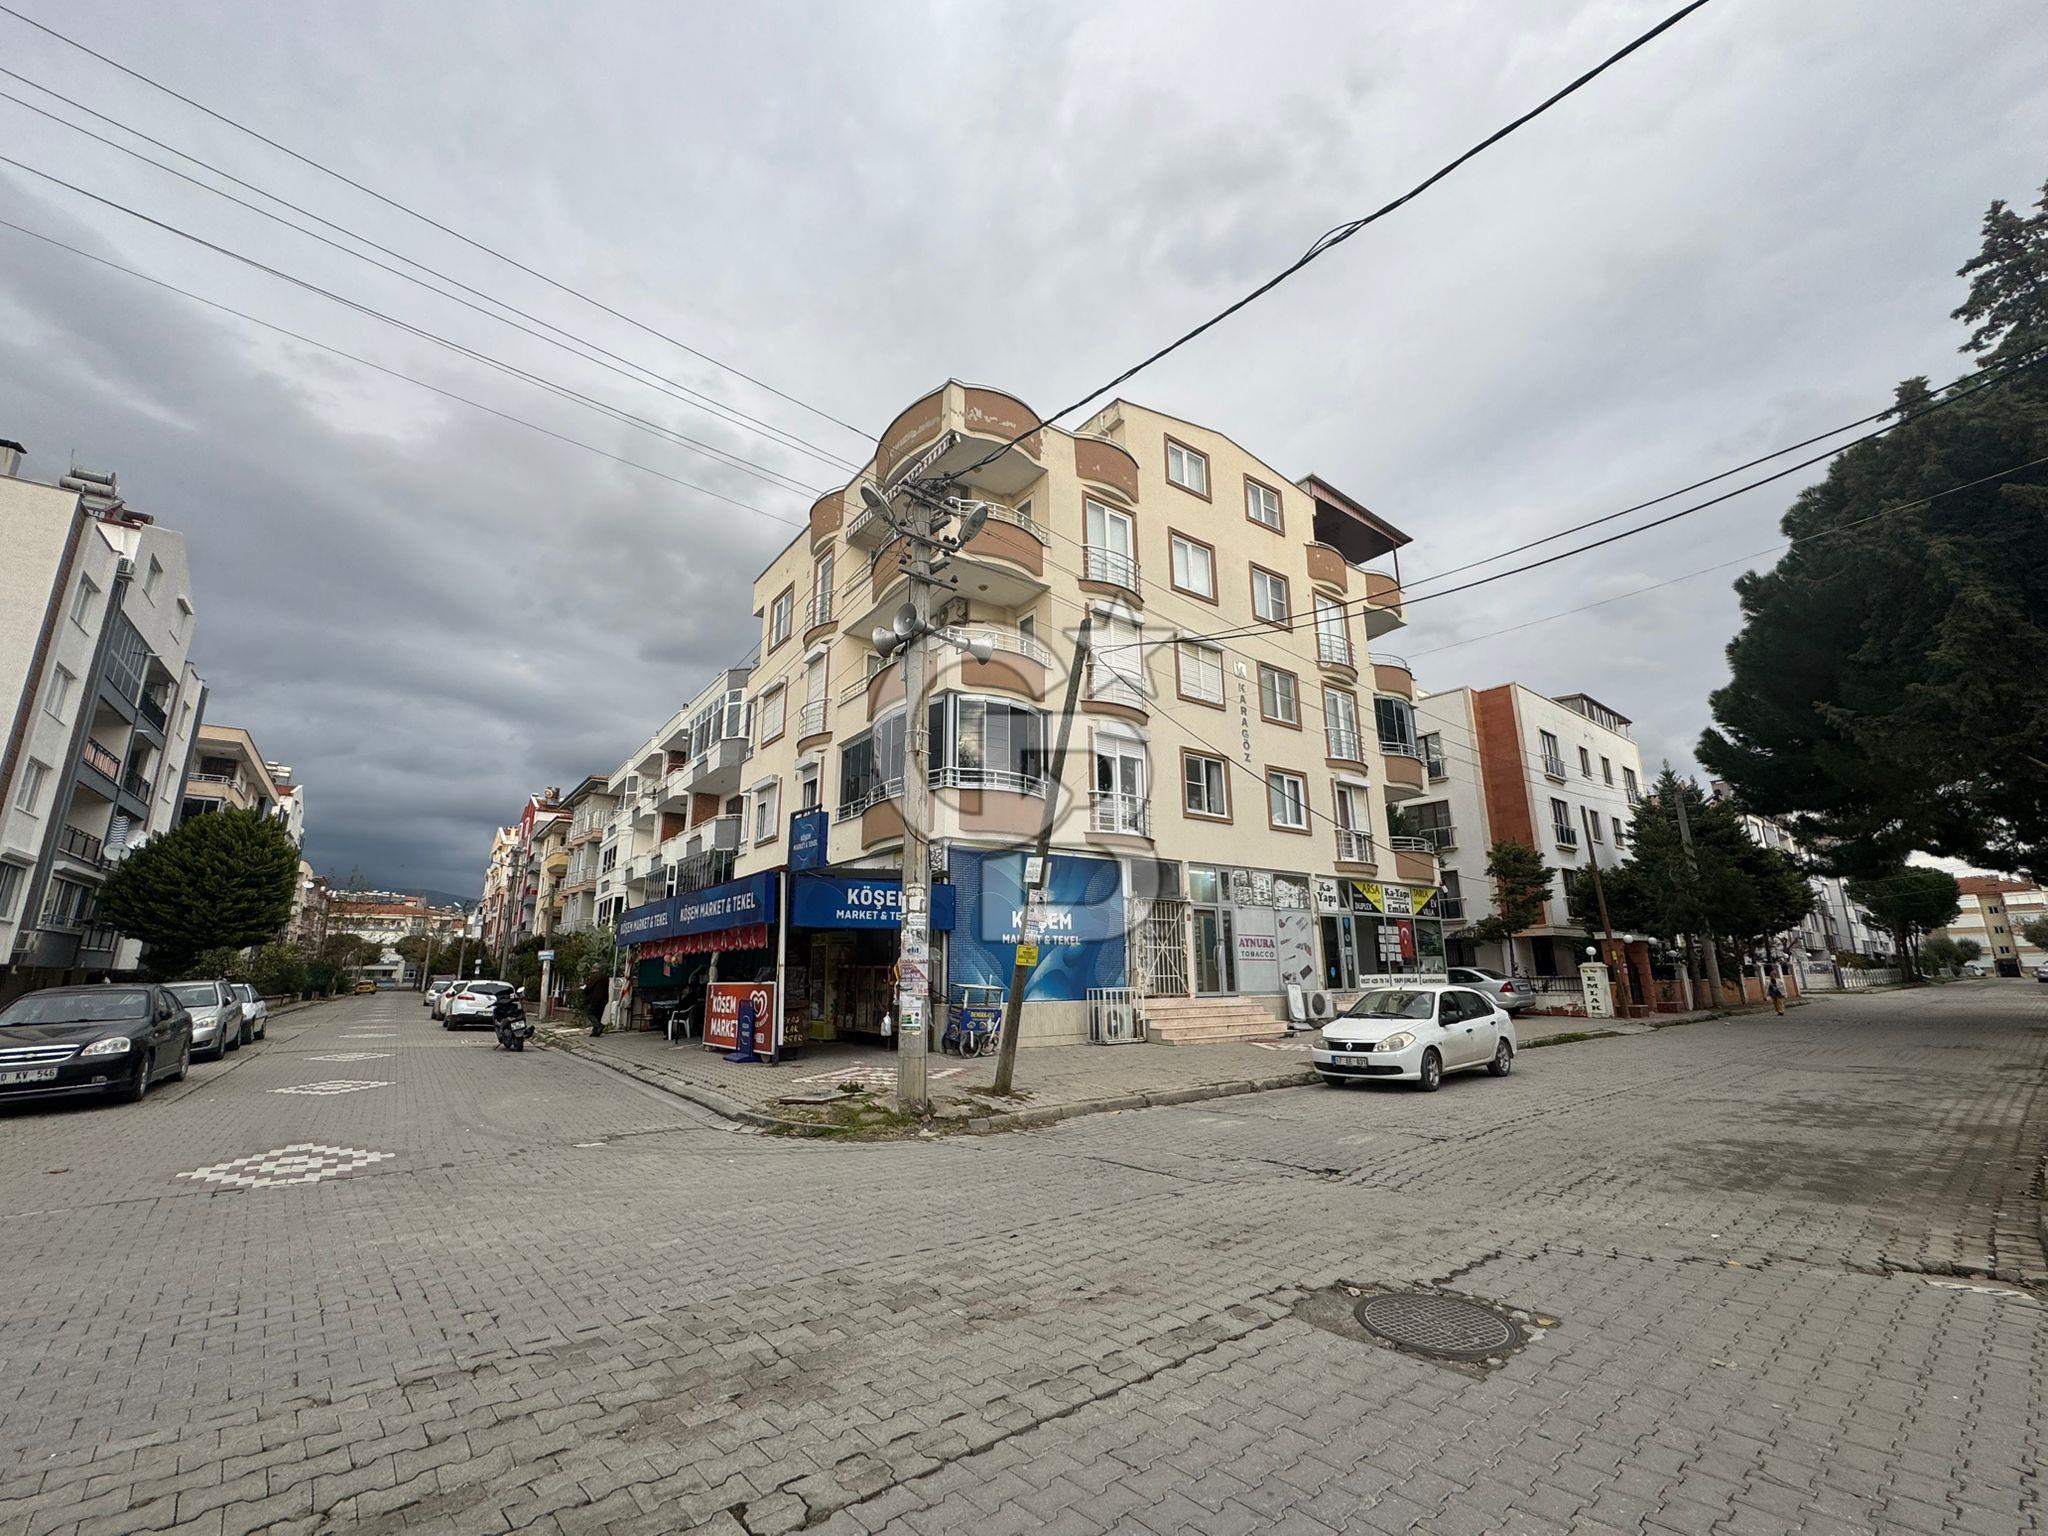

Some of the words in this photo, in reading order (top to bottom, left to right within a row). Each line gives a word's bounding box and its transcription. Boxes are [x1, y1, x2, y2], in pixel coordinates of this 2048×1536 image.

[699, 899, 726, 918] MARKET
[732, 892, 756, 911] TEKEL
[836, 909, 879, 920] MARKET
[880, 911, 887, 920] &
[1044, 935, 1050, 945] &
[1052, 935, 1081, 945] TEKEL
[1238, 937, 1276, 949] AYNURA
[1241, 950, 1275, 958] TOBACCO
[1587, 976, 1602, 1011] EMLAK
